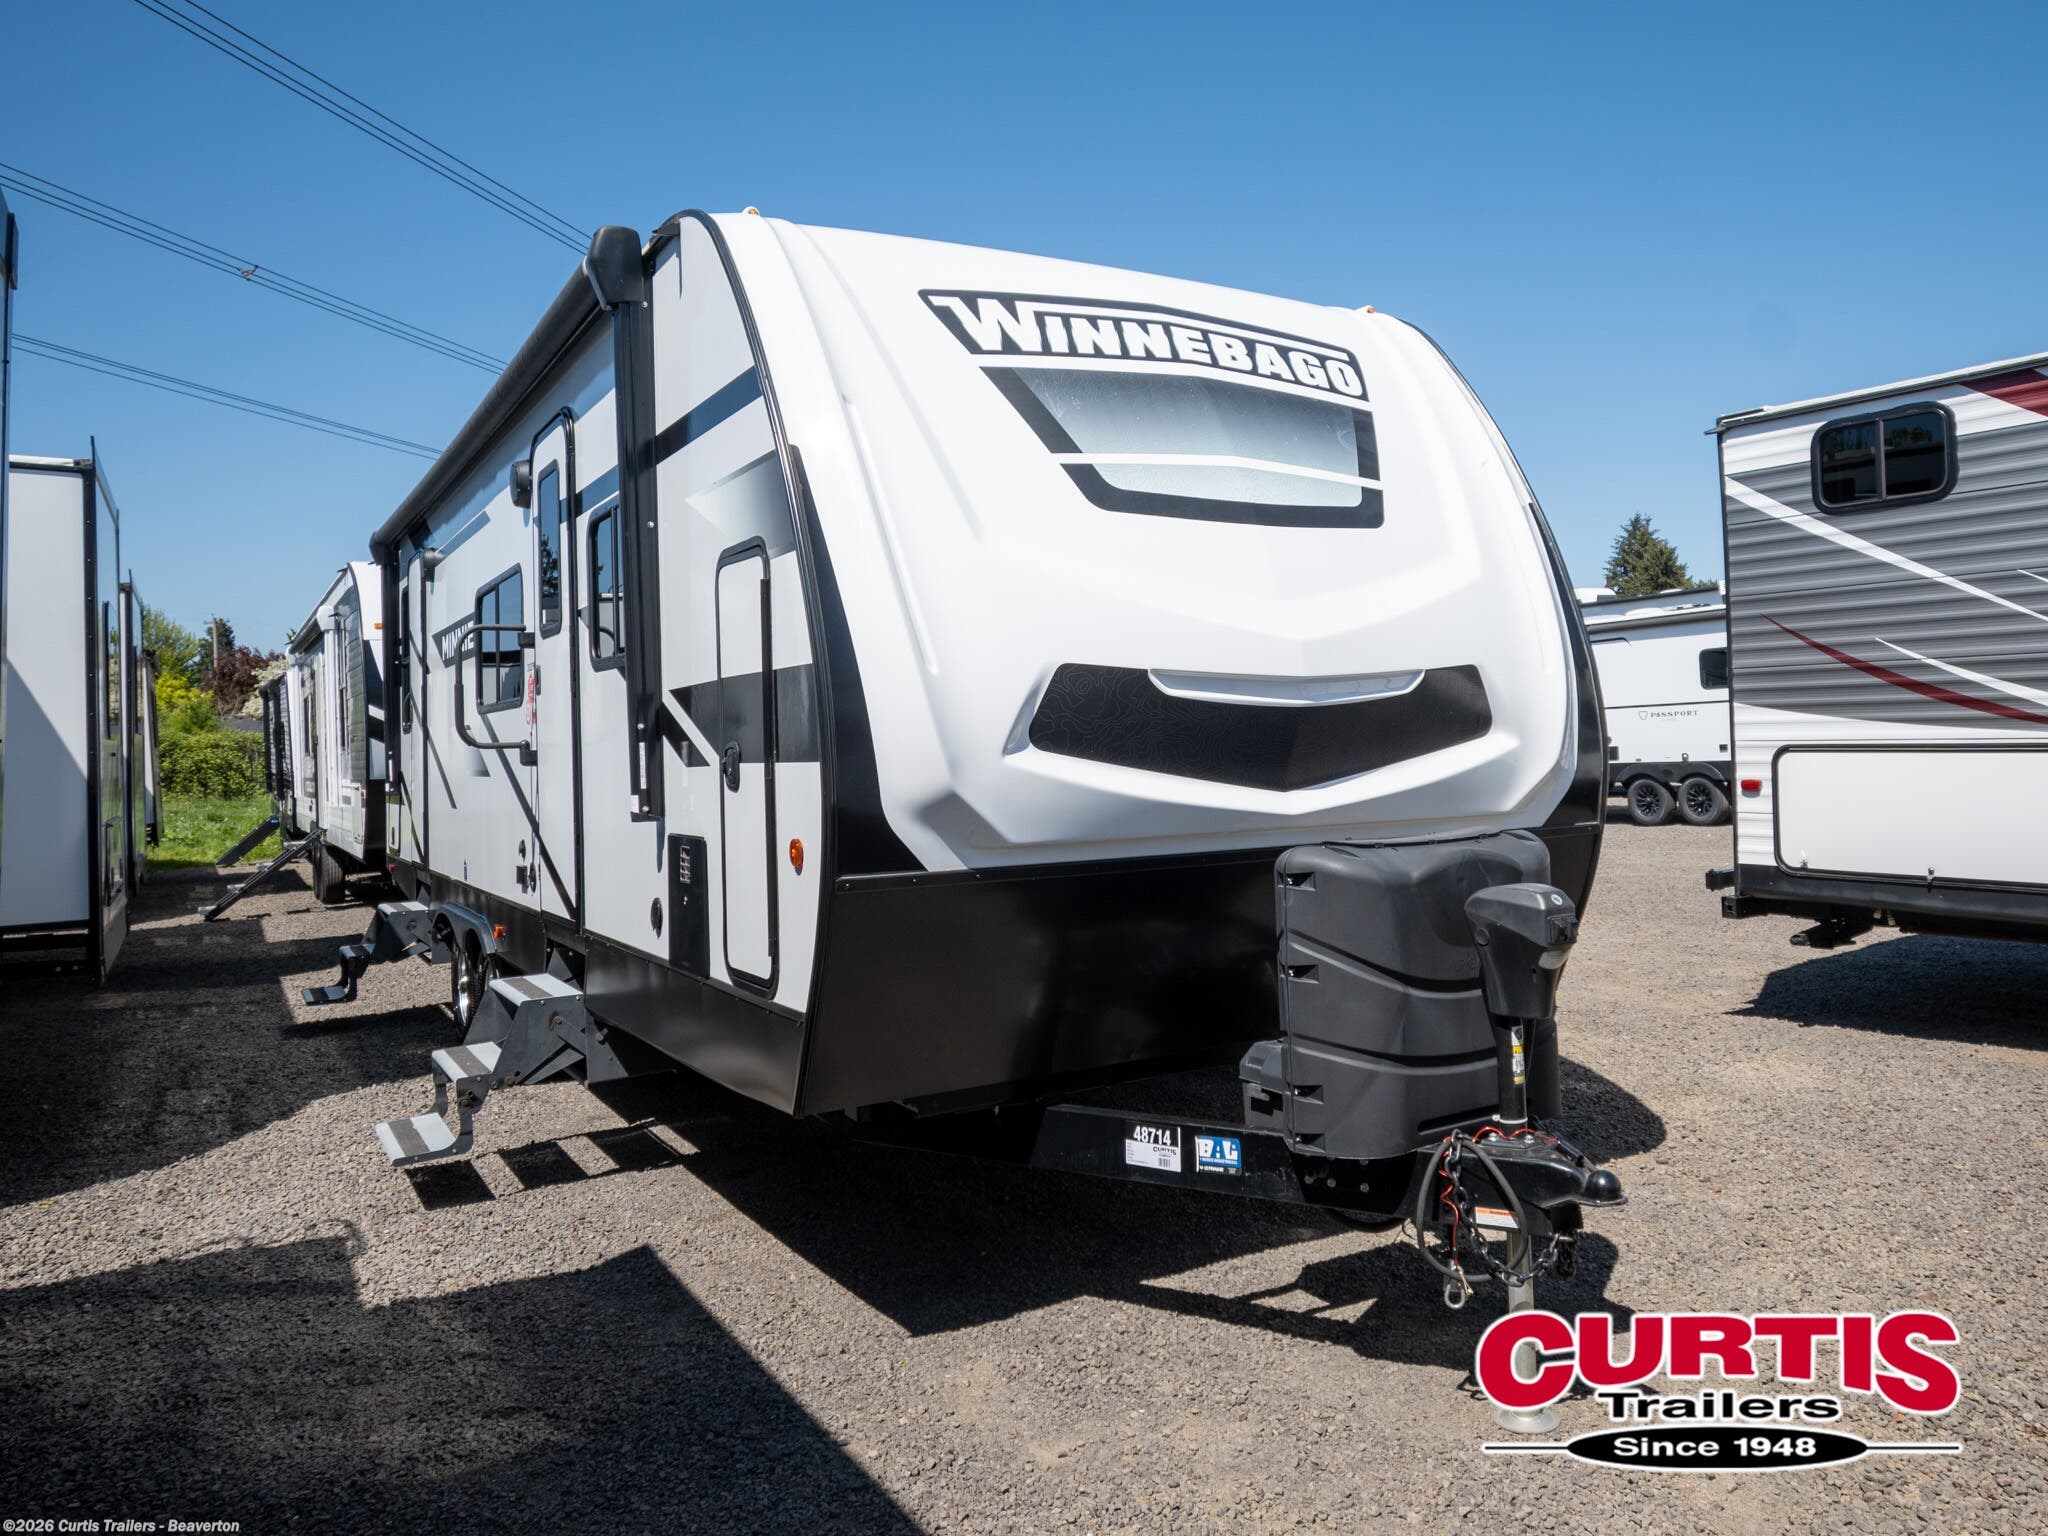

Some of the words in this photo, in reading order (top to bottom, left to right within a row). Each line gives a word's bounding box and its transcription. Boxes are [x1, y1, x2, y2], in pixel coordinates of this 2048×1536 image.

[927, 295, 1364, 397] WINNEBAGO
[1650, 710, 1699, 718] PASSPORT
[1133, 1125, 1172, 1146] 48714
[1152, 1146, 1177, 1156] CURTIS
